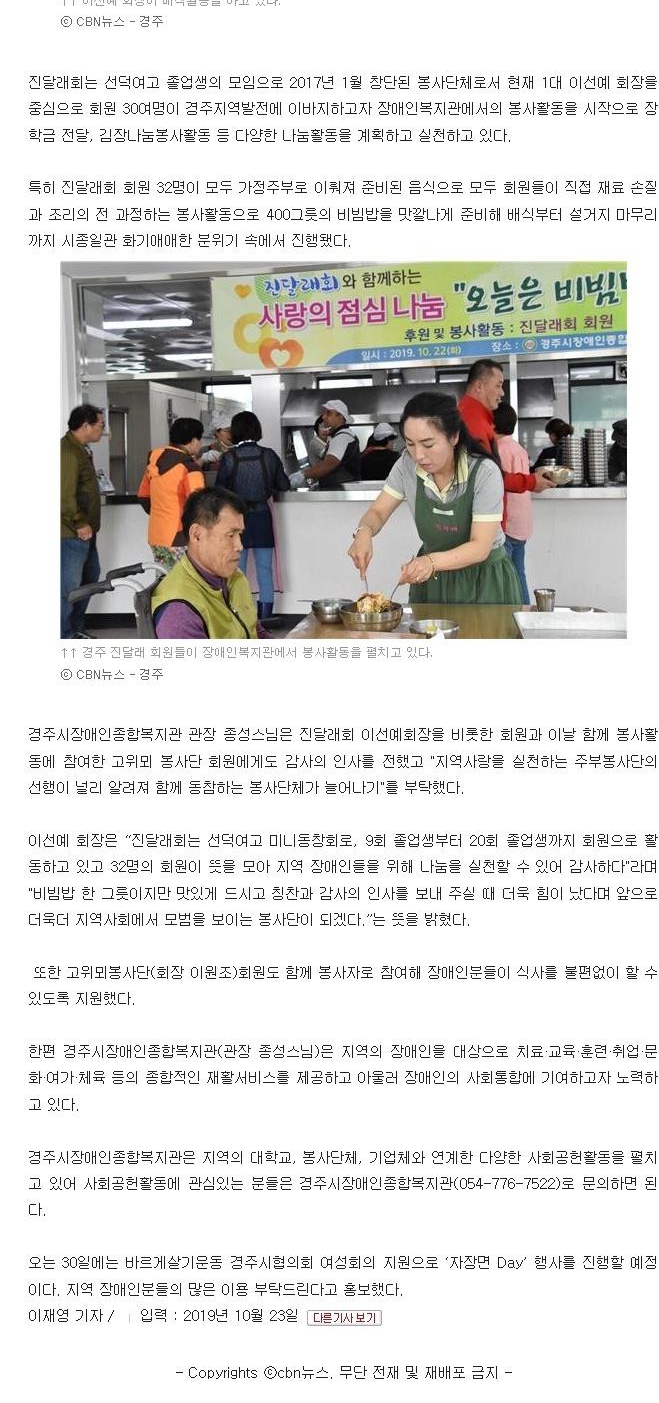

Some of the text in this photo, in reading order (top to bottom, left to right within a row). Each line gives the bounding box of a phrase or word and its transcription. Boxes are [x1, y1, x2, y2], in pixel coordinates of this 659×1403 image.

[77, 16, 163, 27] CBN뉴스 경주
[29, 234, 350, 247] 까지 시종일관 화기애애한 분위기 속에서 진행됐다.
[362, 269, 422, 288] 함께하는
[453, 276, 543, 314] "오늘은
[258, 292, 445, 330] 사랑의 점심 나눔
[404, 314, 614, 343] 후원 및 봉사활동 진달래회 회원
[491, 341, 512, 353] 장소
[361, 349, 380, 361] 일시
[389, 349, 416, 359] 2019.
[418, 347, 431, 358] 10.
[83, 647, 432, 658] 경주 진달래 회원들이 장애인복지관에서 봉사활동을 펼치고 있다.
[77, 669, 163, 680] CBN뉴스 경주
[29, 781, 463, 794] 선행이 널리 알려져 함께 동참하는 봉사단체가 늘어나기"를 부탁했다.
[29, 992, 134, 1005] 있도록 지원했다.
[29, 1098, 78, 1111] 고 있다.
[29, 1309, 297, 1322] 이재영 기자 입력 2019년 10월 23일
[314, 1313, 375, 1323] 다른기사 보기
[189, 1367, 257, 1379] Copyrights
[340, 1366, 367, 1379] 무단
[373, 1366, 398, 1379] 전재
[406, 1366, 418, 1379] 및
[425, 1366, 465, 1379] 재배포
[472, 1366, 497, 1379] 금지
